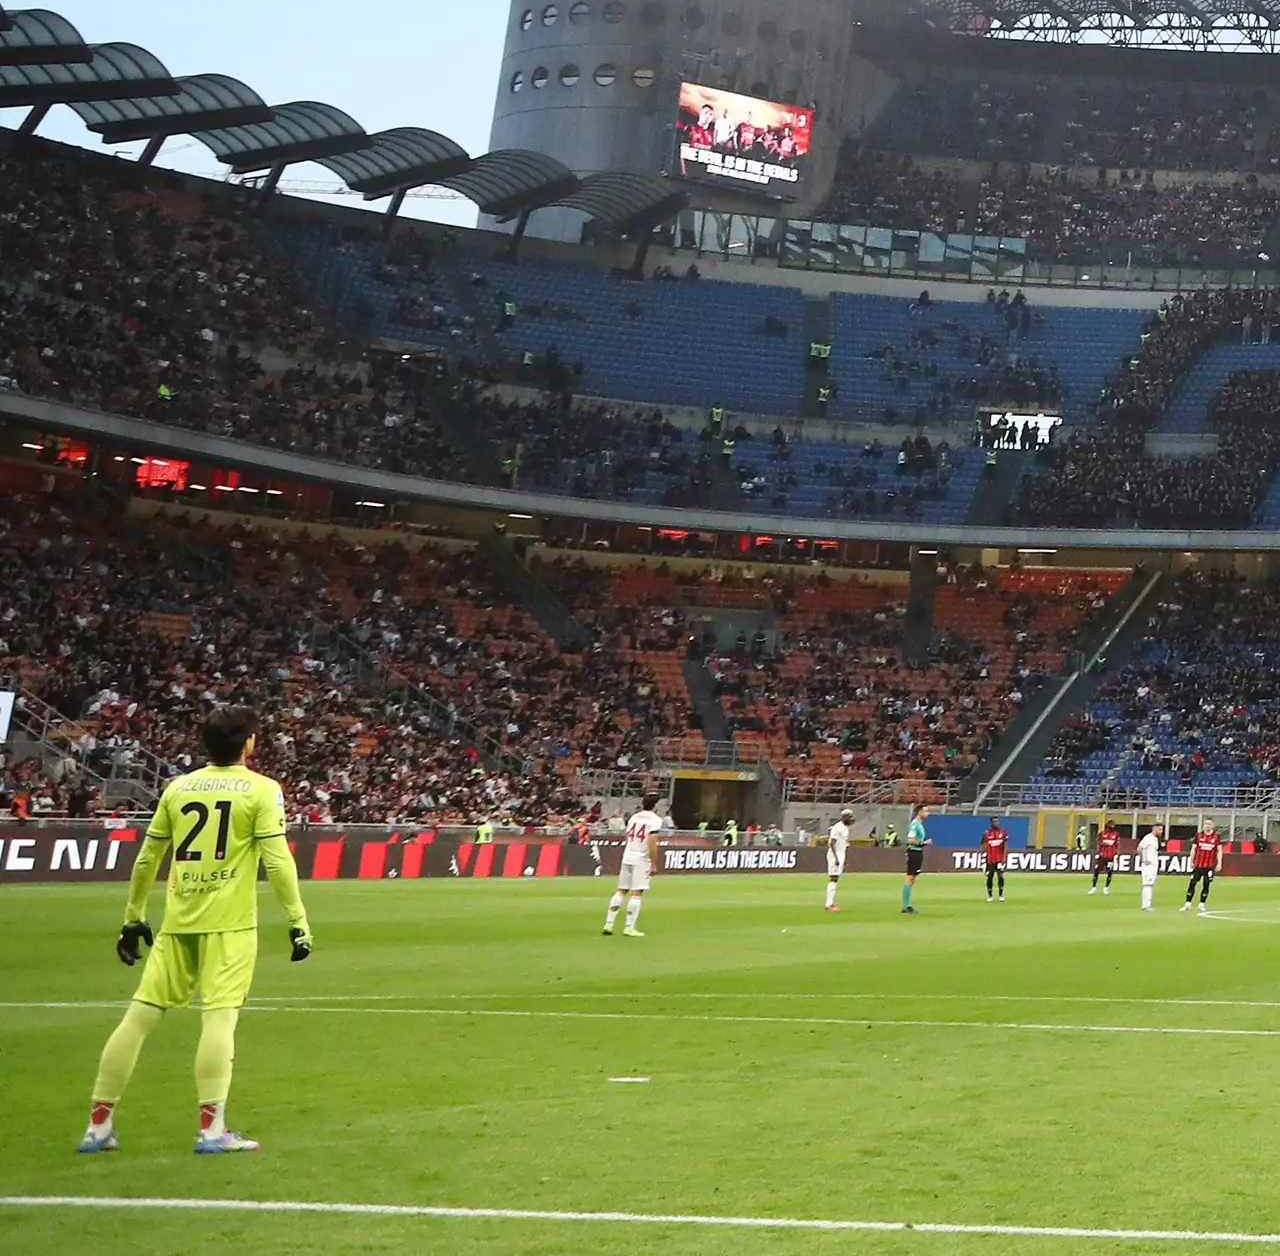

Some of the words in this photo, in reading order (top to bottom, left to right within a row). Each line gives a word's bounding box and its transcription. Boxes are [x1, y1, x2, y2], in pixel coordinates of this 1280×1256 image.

[176, 801, 232, 861] 21
[628, 823, 646, 842] 44
[664, 850, 686, 868] THE
[685, 850, 715, 868] DEVIL
[715, 850, 727, 868] IS
[726, 850, 739, 868] IN
[739, 850, 760, 868] THE
[758, 851, 797, 868] DETAILS
[1050, 853, 1068, 870] IS
[1071, 853, 1091, 870] IN
[183, 868, 237, 882] PULSEE
